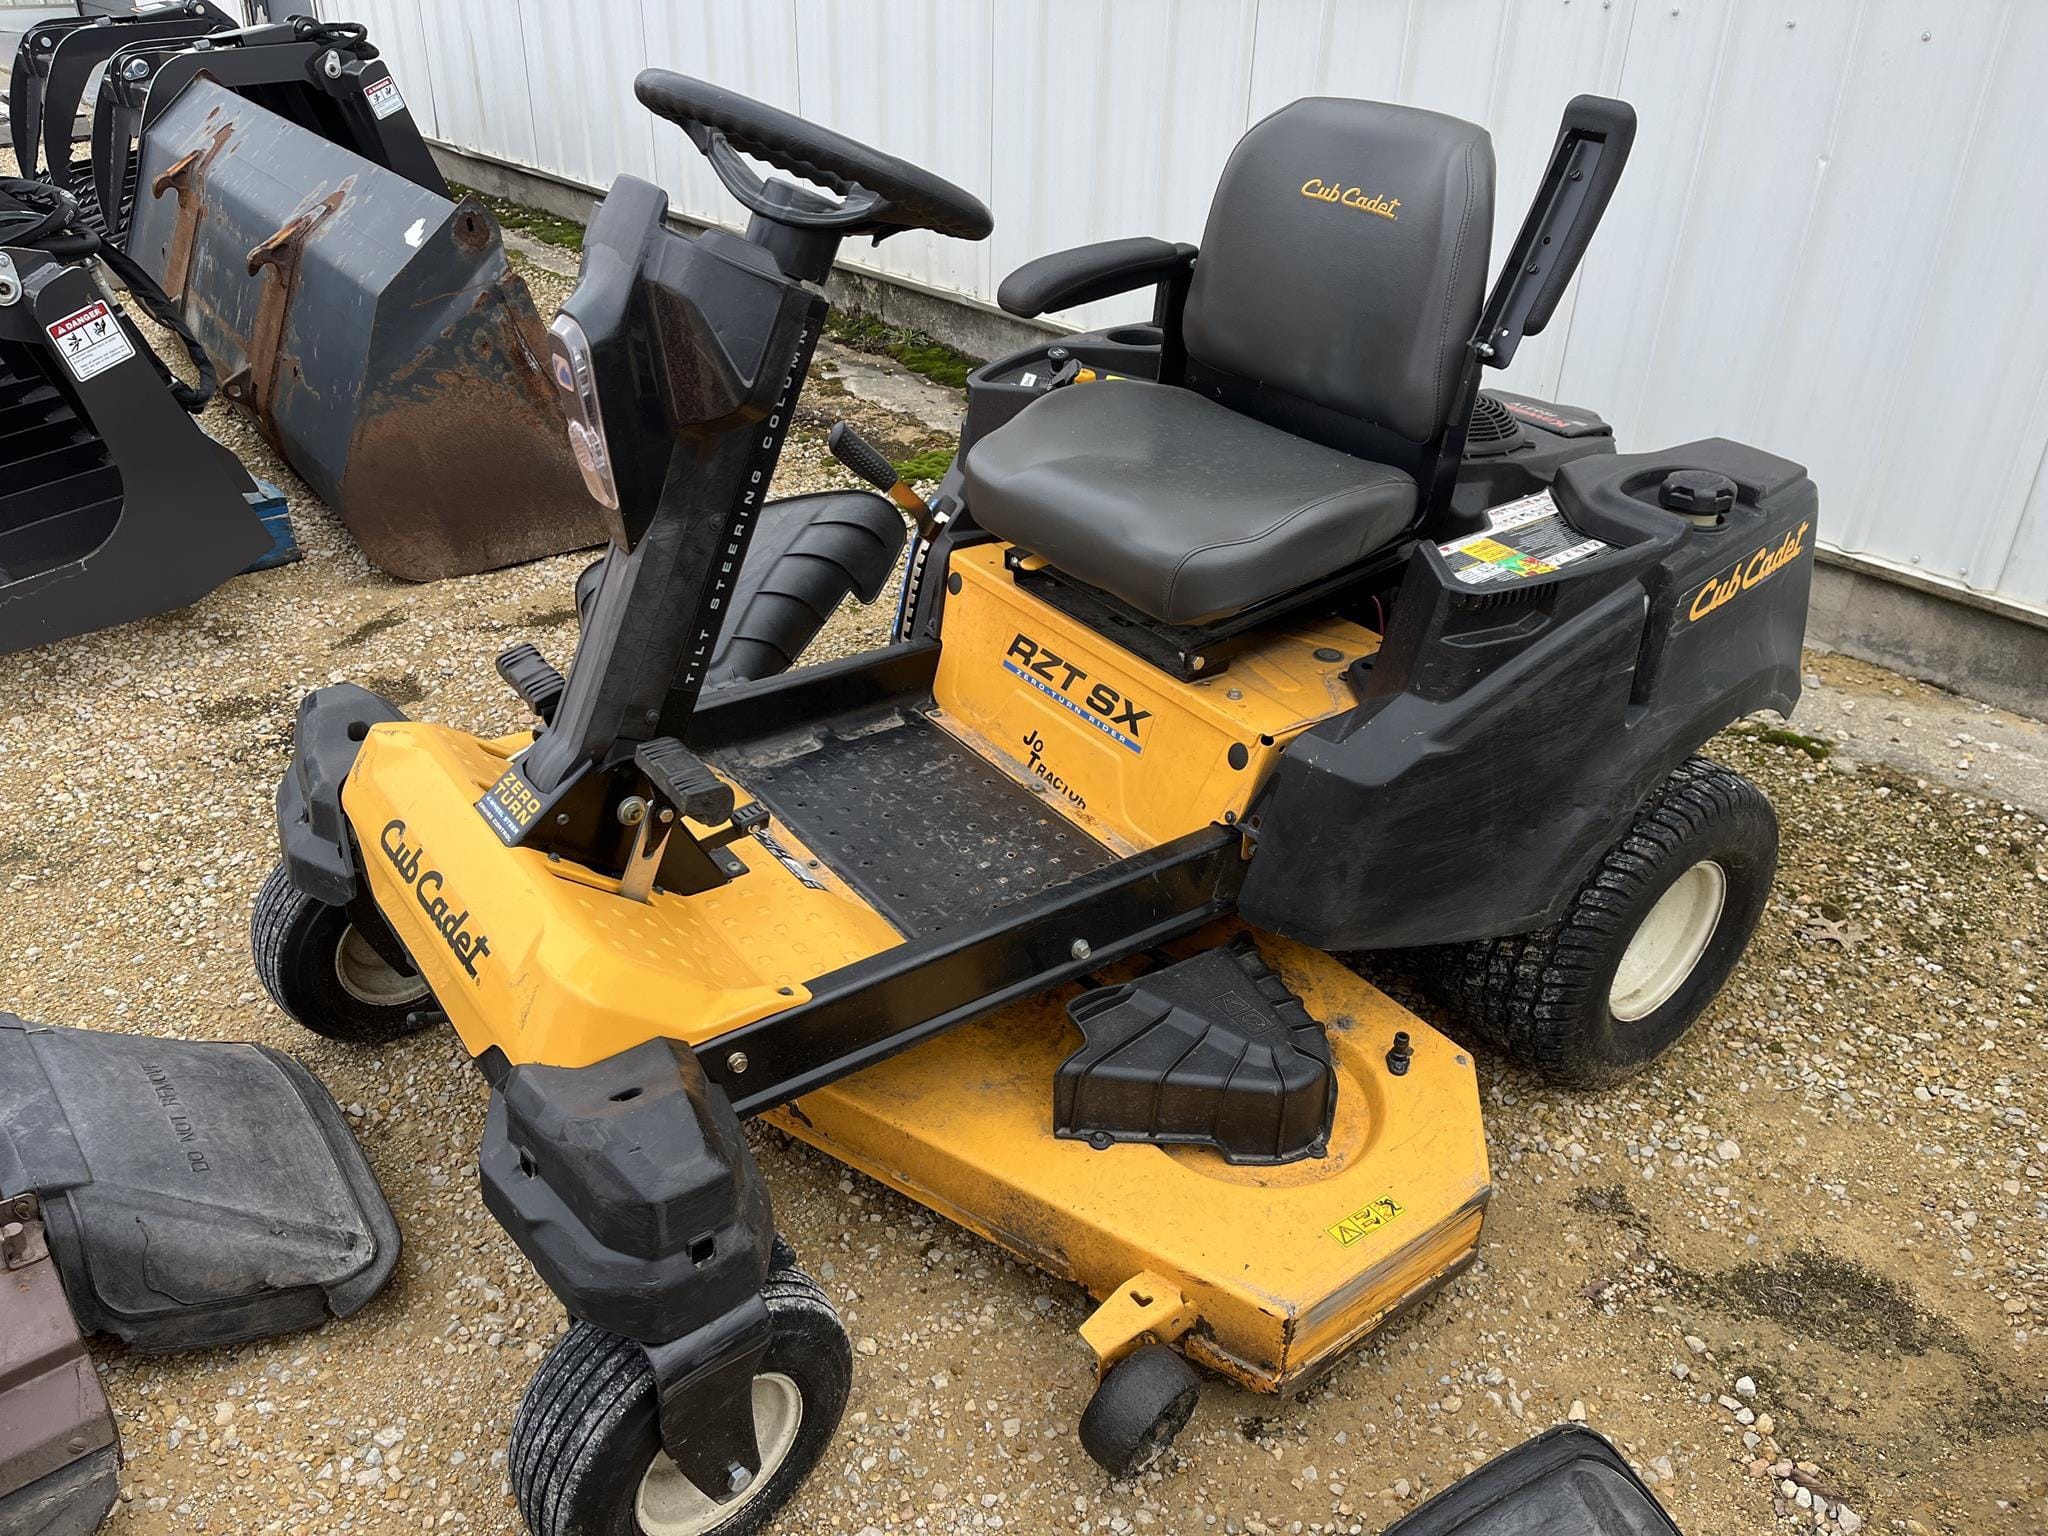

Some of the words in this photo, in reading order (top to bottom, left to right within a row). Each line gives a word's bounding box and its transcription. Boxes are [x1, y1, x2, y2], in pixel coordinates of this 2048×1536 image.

[1300, 178, 1341, 203] Cub
[1341, 186, 1402, 220] Cadet
[65, 307, 103, 331] DANGER
[685, 629, 709, 684] TILT
[710, 470, 762, 610] STEERING
[762, 328, 808, 449] COLUMN
[1689, 562, 1742, 622] Cub
[1742, 521, 1809, 590] Cadet
[1006, 633, 1088, 691] RZT
[1086, 683, 1153, 738] SX
[1015, 668, 1082, 715] ZERO-TURN
[1088, 714, 1126, 744] RIDER
[494, 782, 532, 826] TURN
[503, 771, 541, 814] ZERO
[478, 801, 494, 820] CRUISE
[492, 818, 512, 842] CONTROL
[503, 816, 520, 834] STEER
[380, 819, 424, 885] Cub
[416, 870, 491, 980] Cadet
[168, 1116, 195, 1142] NOT
[187, 1151, 209, 1172] DO
